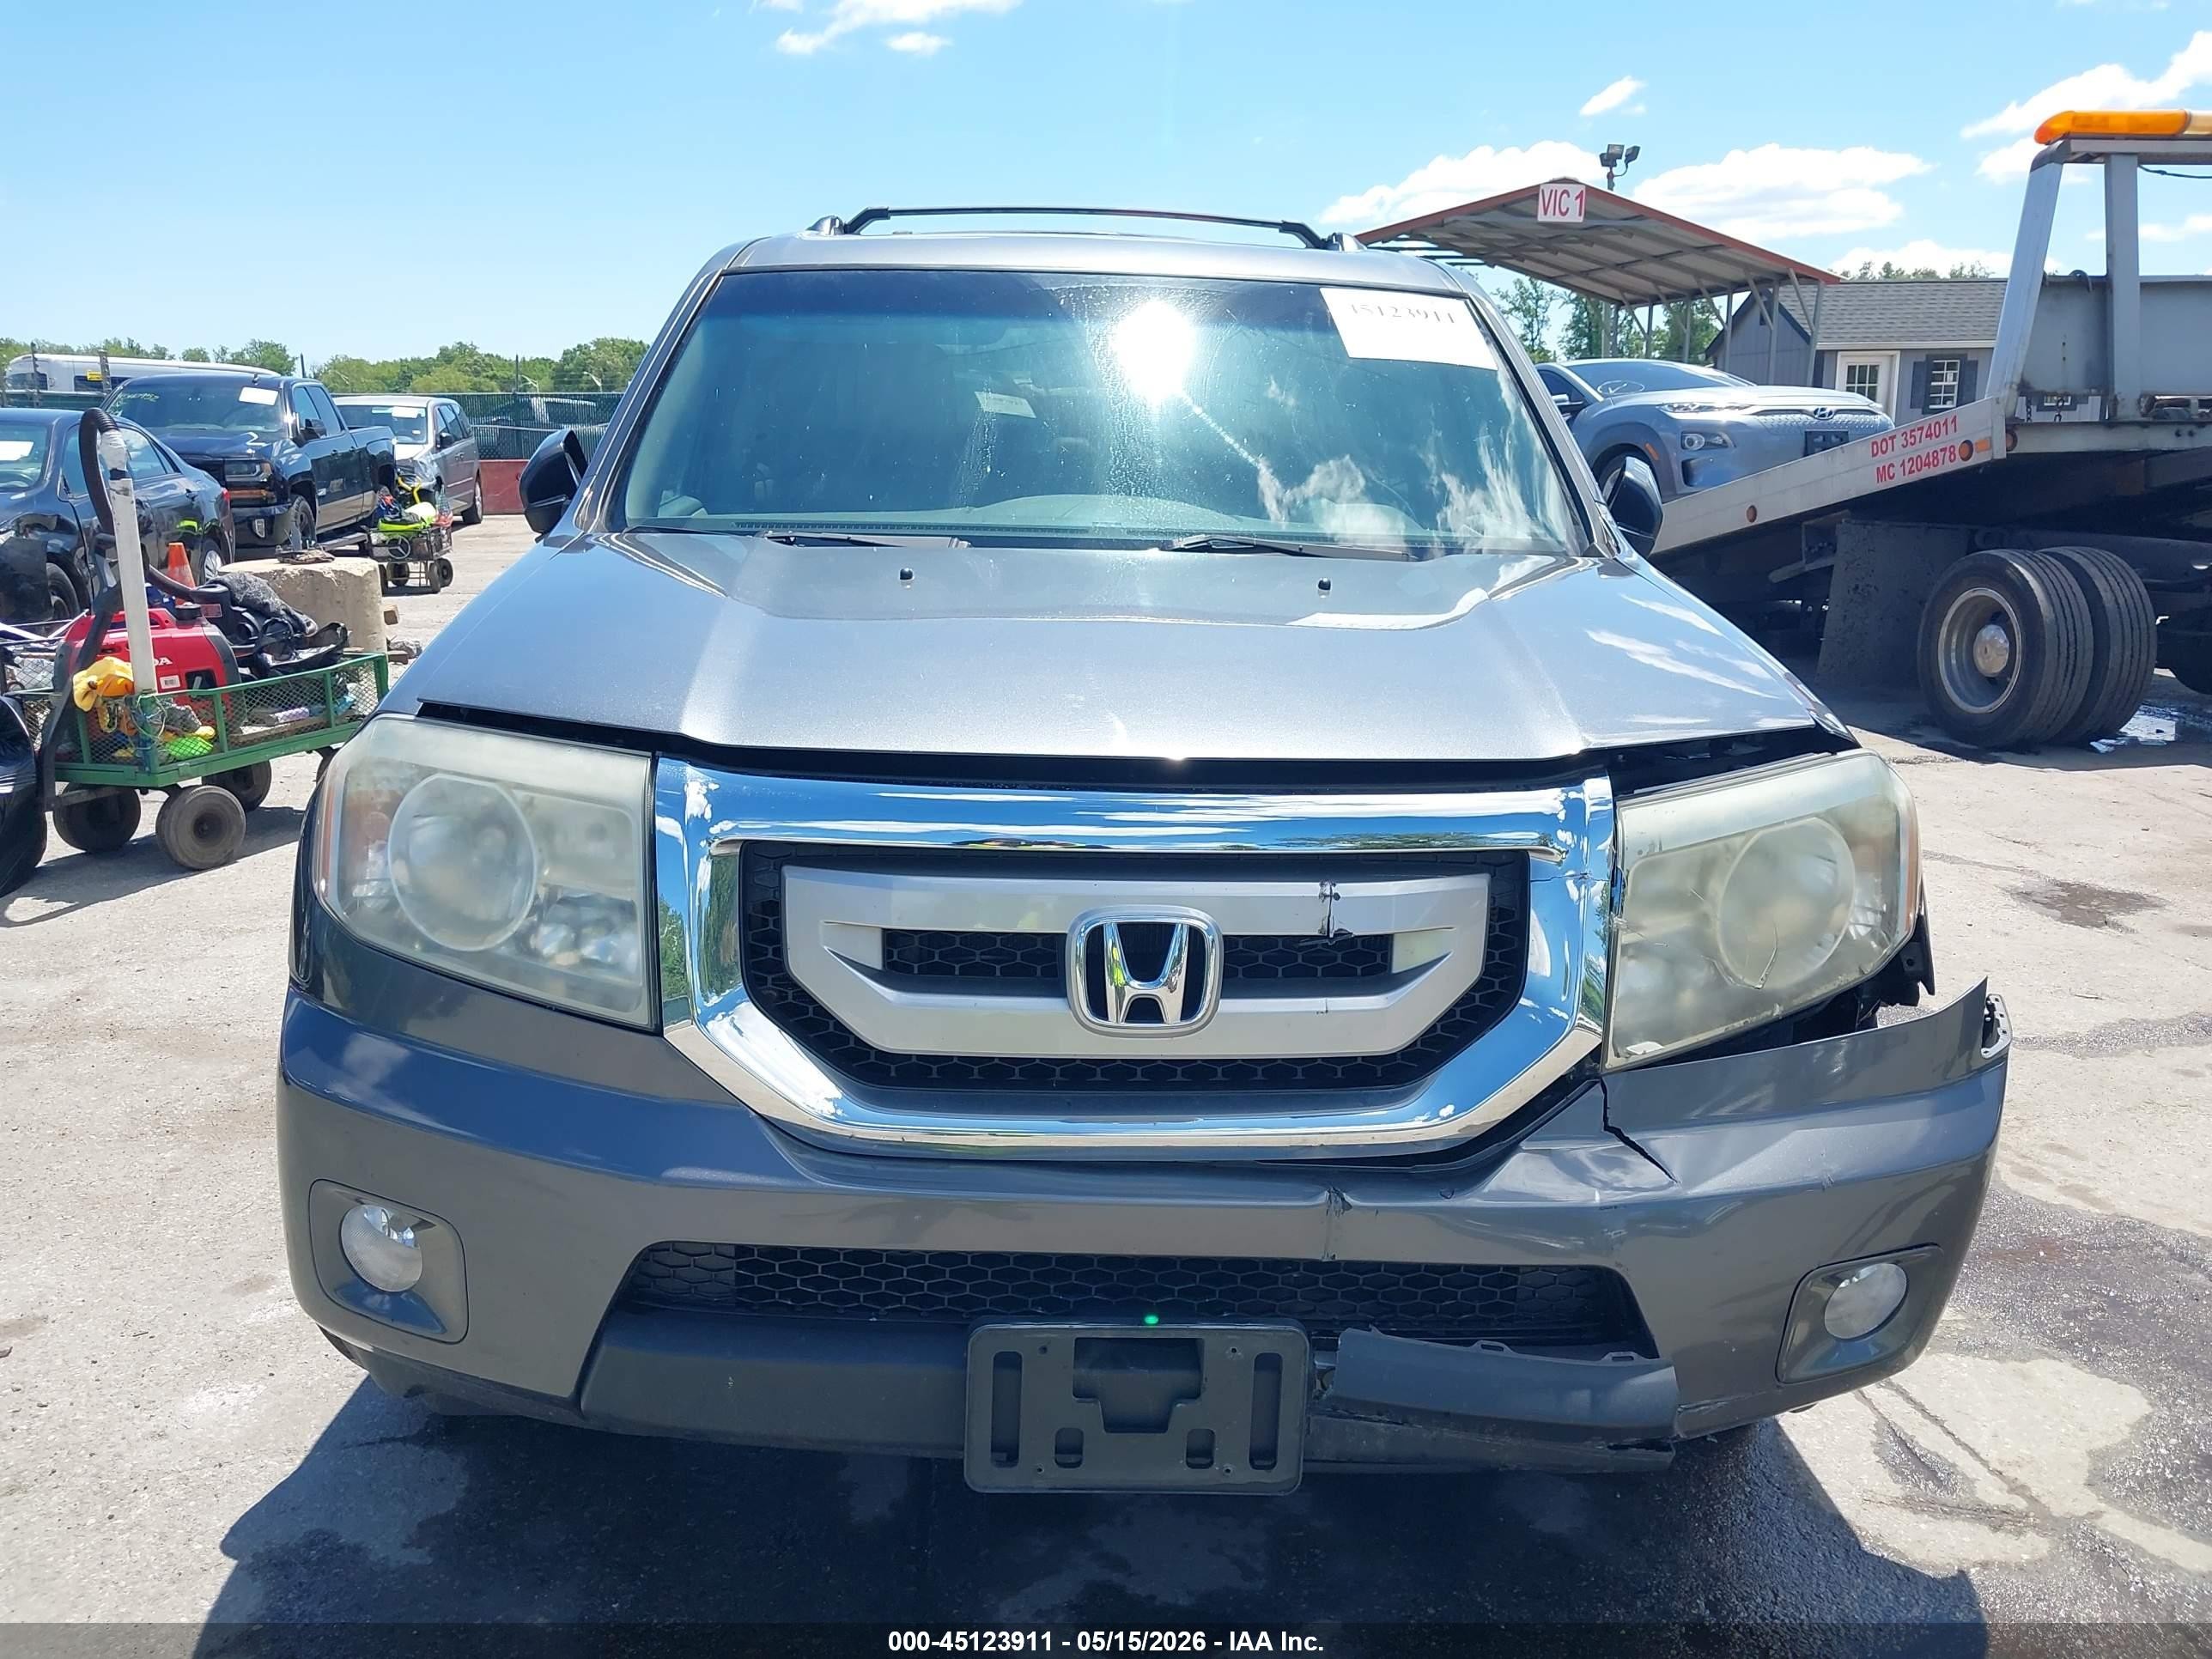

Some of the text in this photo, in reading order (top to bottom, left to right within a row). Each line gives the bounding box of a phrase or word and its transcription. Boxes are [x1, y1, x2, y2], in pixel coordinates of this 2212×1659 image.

[1541, 188, 1584, 217] VIC 1
[1871, 415, 1958, 458] DOT 3574011
[1876, 445, 1957, 483] MC 1204878
